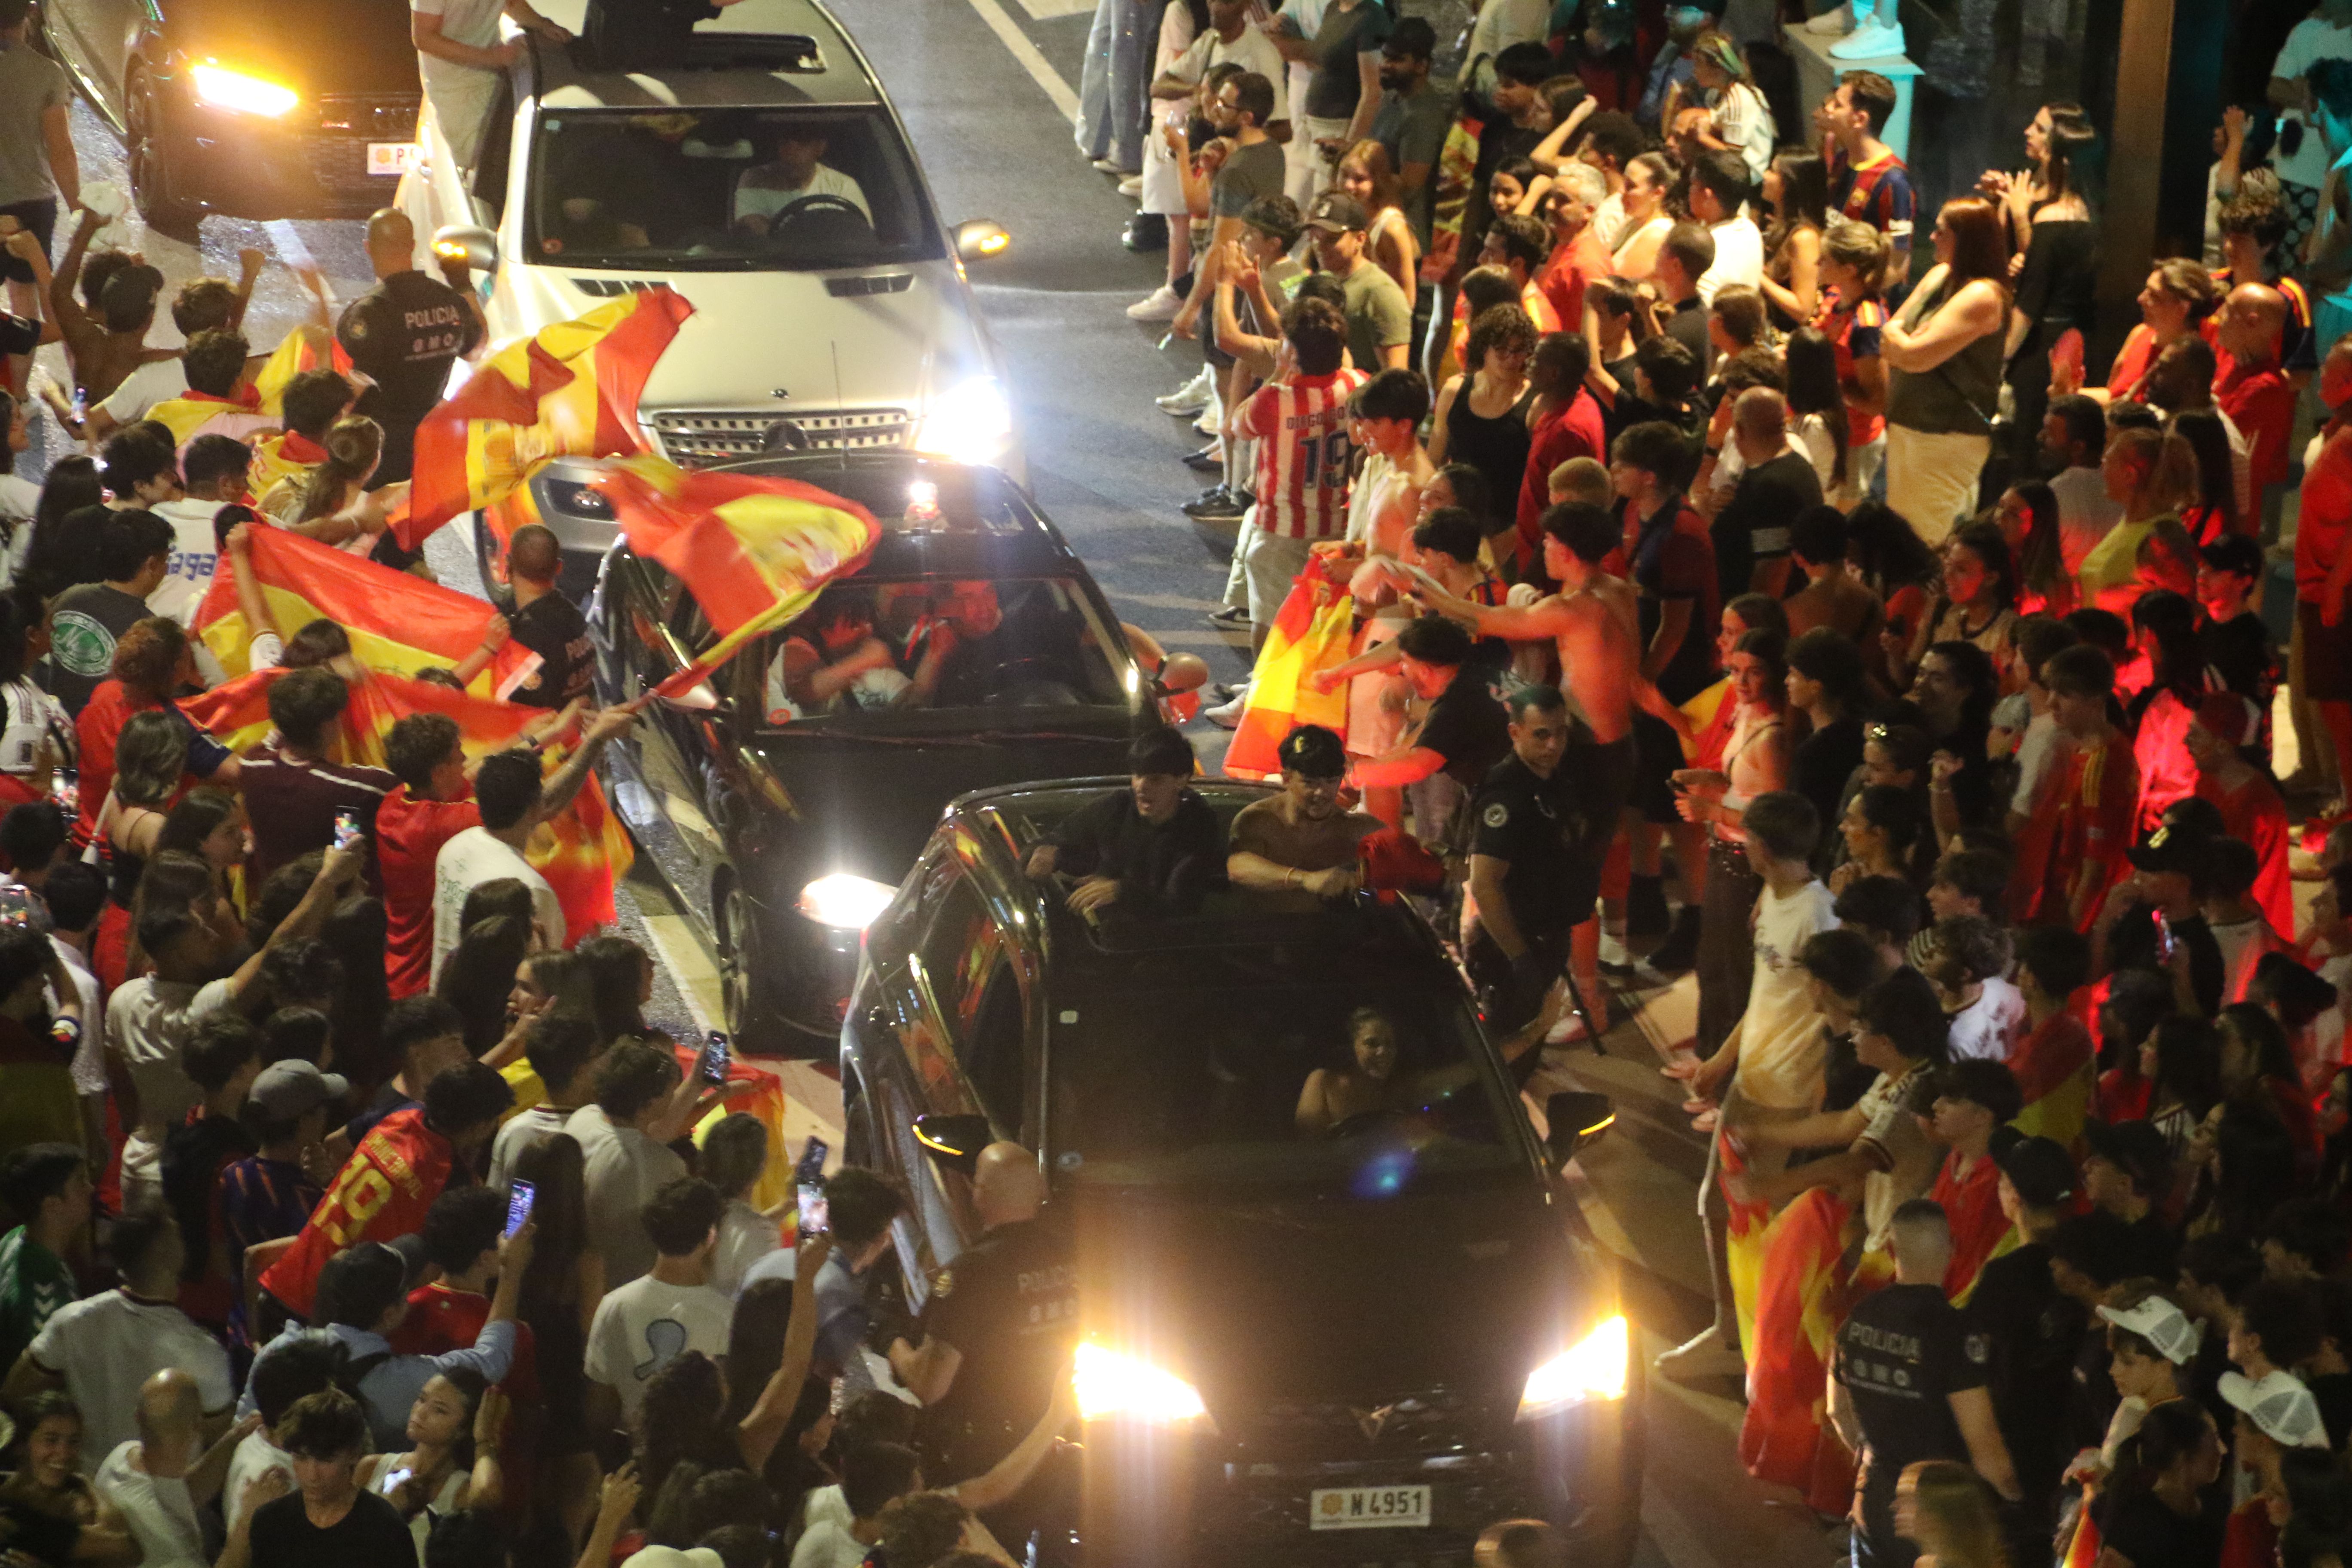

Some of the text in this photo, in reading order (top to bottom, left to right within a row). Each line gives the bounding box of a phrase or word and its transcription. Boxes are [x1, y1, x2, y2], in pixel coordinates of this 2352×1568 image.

[405, 305, 460, 330] POLICIA
[1286, 413, 1324, 429] DIEGO
[1299, 431, 1350, 488] 19
[1848, 1321, 1922, 1358] POLICIA
